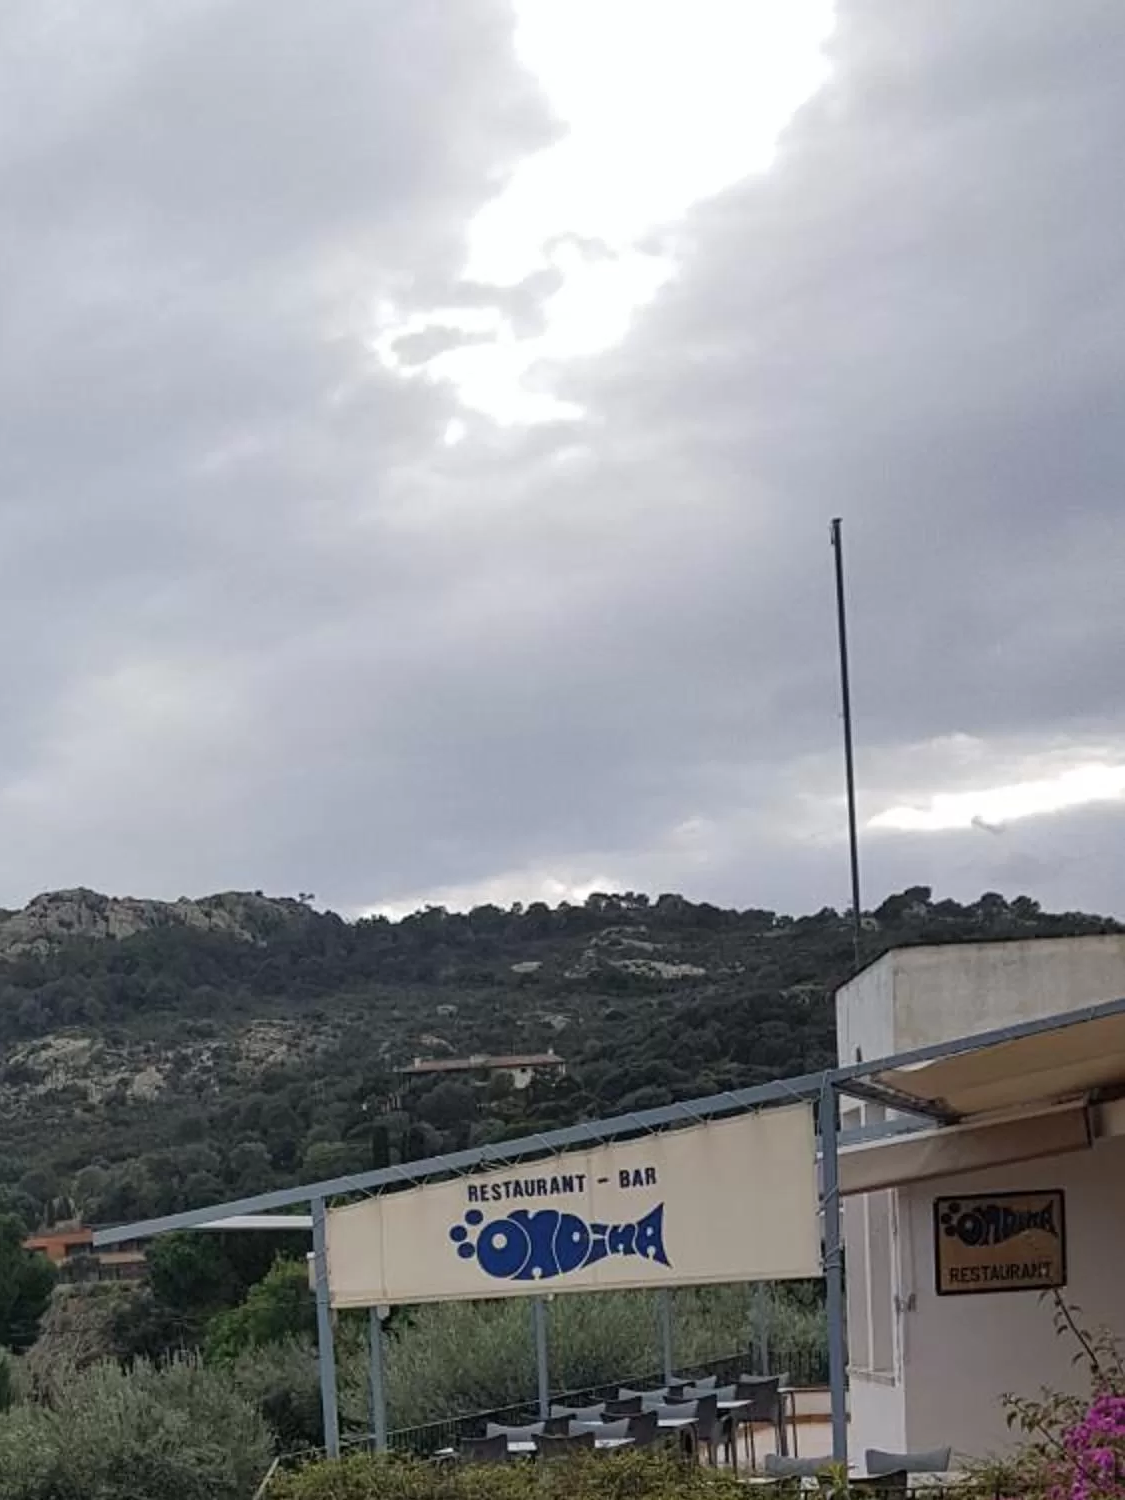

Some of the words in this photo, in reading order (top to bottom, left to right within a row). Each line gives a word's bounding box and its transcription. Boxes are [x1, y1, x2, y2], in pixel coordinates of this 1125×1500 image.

[468, 1174, 586, 1202] RESTAURANT
[619, 1167, 657, 1189] BAR
[949, 1261, 1053, 1282] RESTAURANT
